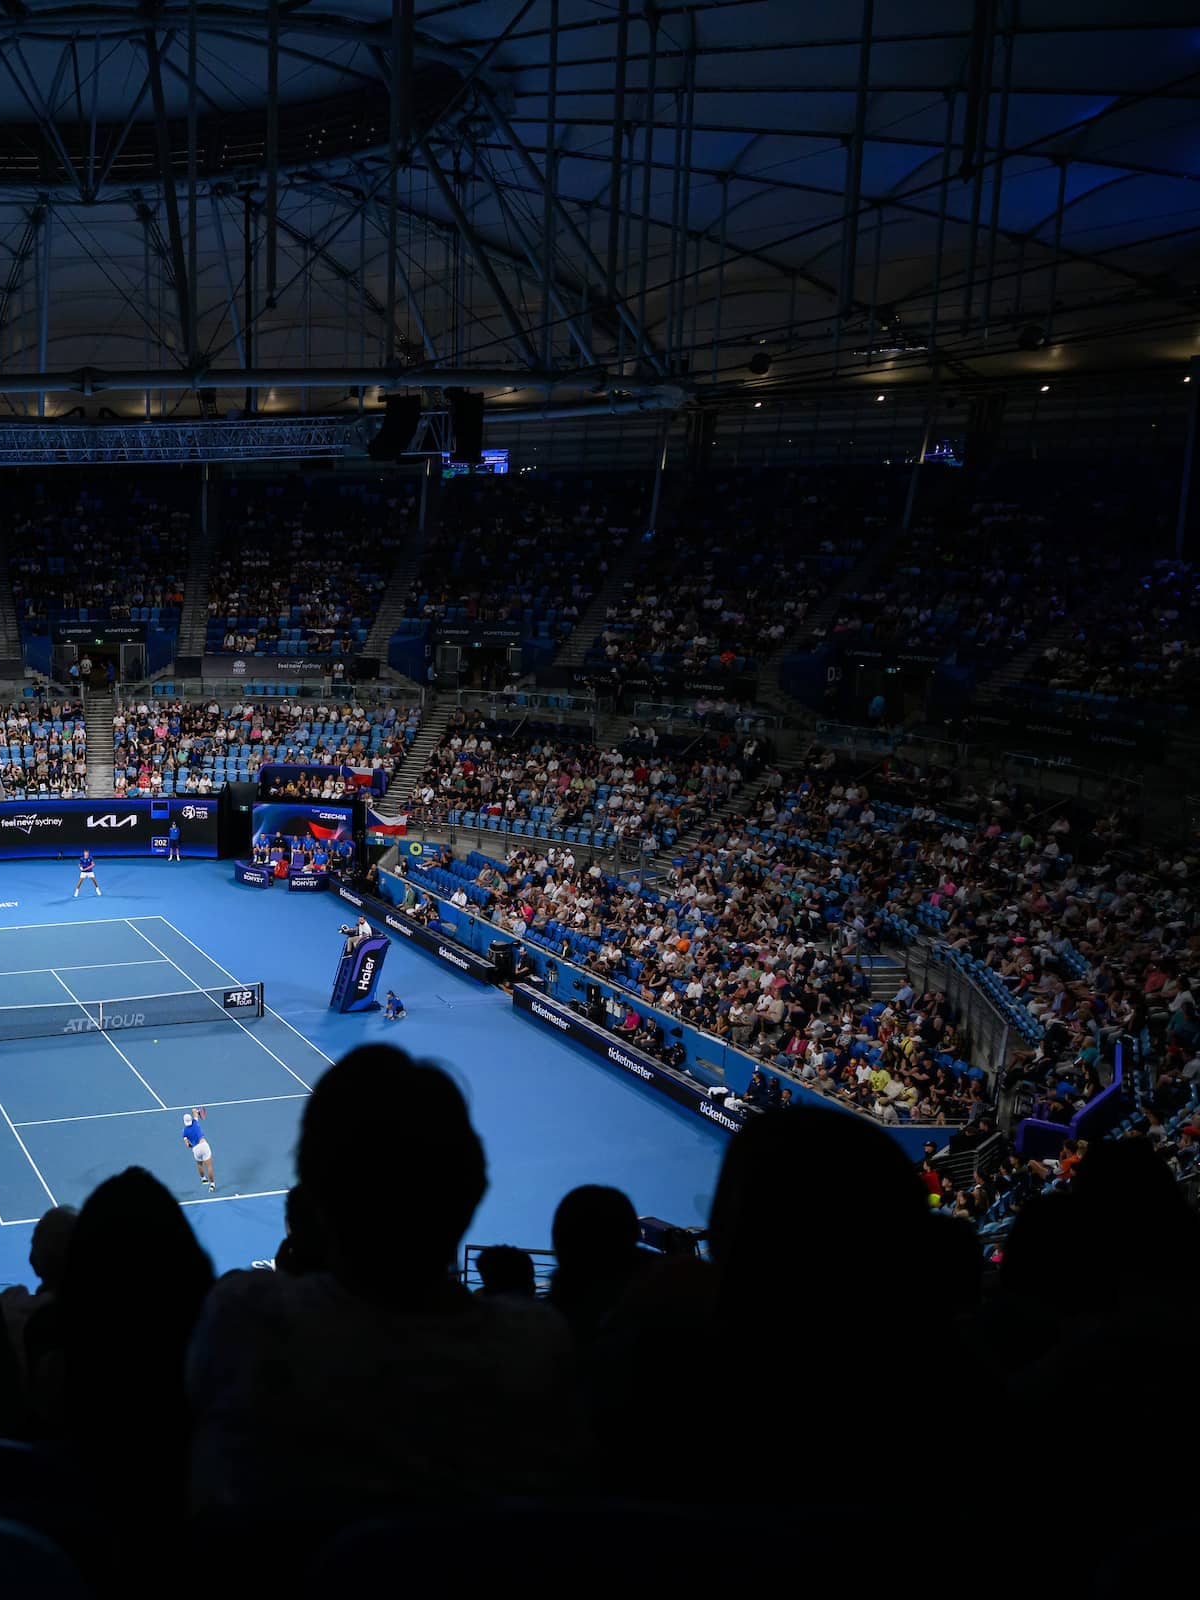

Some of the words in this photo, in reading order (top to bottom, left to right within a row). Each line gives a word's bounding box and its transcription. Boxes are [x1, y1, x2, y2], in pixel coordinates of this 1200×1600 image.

[1, 819, 16, 828] feel
[35, 817, 63, 827] sydney
[319, 812, 347, 821] CZECHIA
[153, 839, 168, 847] 202
[357, 957, 375, 990] Haier
[103, 1013, 145, 1029] TOUR
[531, 1001, 569, 1030] ticketmaster
[608, 1047, 652, 1080] ticketmaster
[699, 1101, 742, 1133] ticketmas
